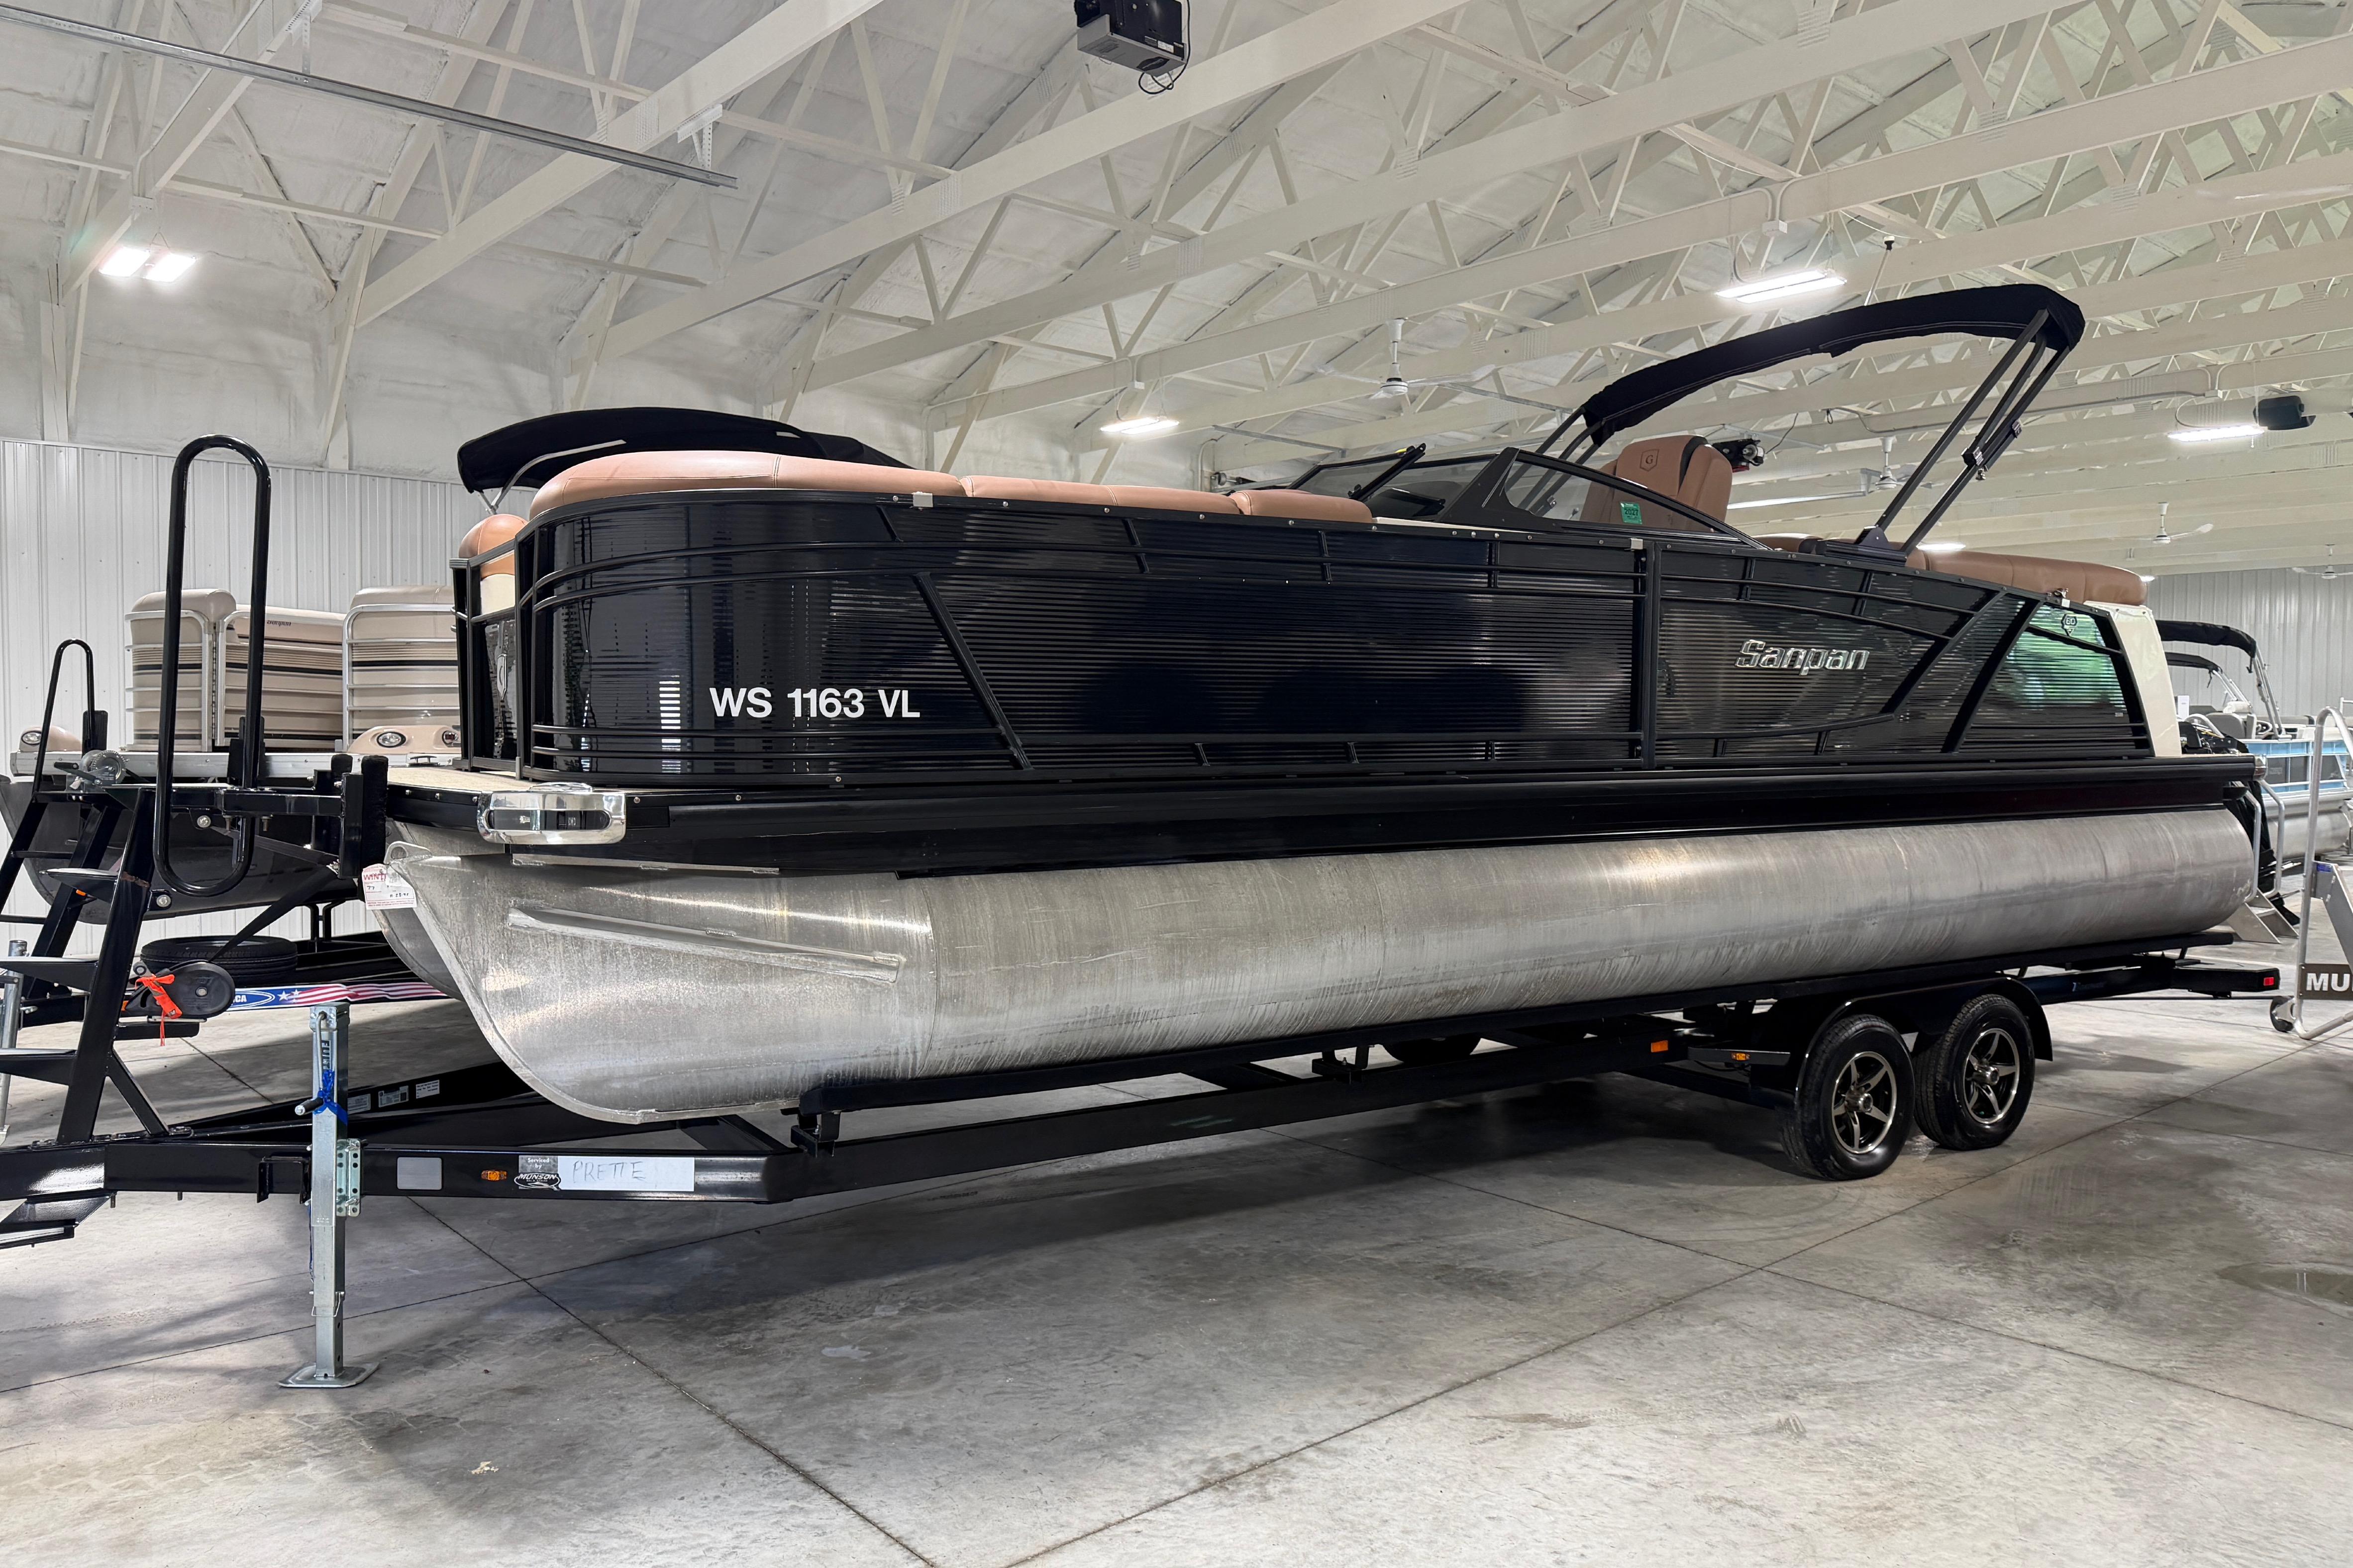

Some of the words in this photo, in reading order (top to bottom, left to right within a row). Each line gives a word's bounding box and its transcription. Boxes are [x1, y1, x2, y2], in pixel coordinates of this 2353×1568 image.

[1646, 455, 1653, 464] G
[1735, 639, 1870, 676] Sanpan
[710, 687, 772, 718] WS
[787, 688, 865, 718] 1163
[878, 689, 921, 717] VL
[2306, 973, 2353, 991] MU
[321, 1040, 330, 1070] FULT
